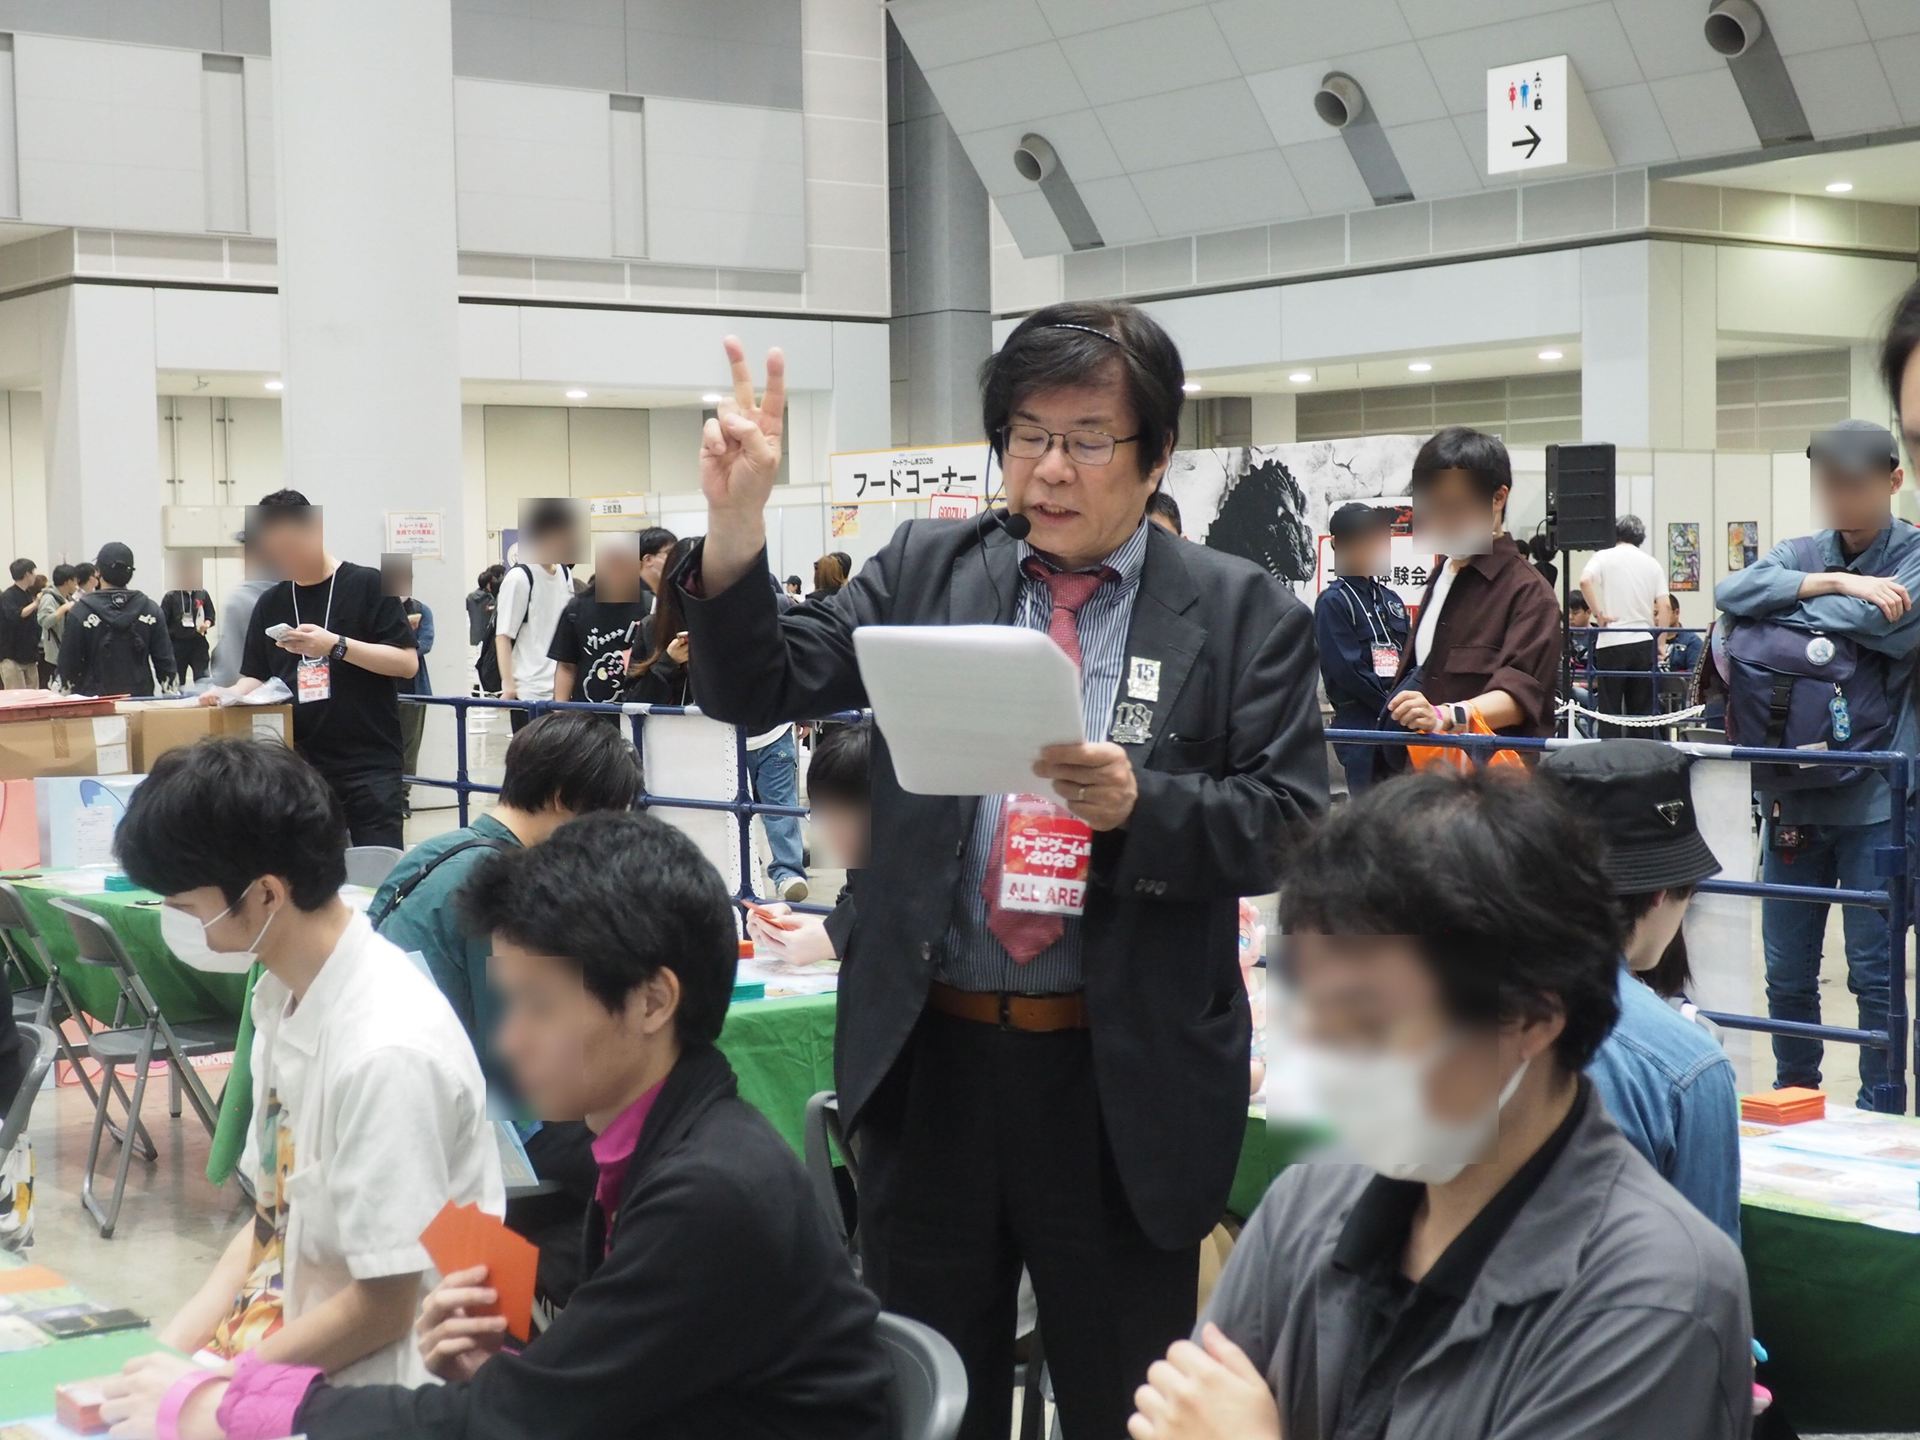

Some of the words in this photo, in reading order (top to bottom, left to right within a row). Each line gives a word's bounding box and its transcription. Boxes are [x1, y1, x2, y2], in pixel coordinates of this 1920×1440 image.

[853, 465, 977, 498] フードコーナー
[1028, 850, 1077, 869] 2026
[1008, 882, 1040, 903] ALL
